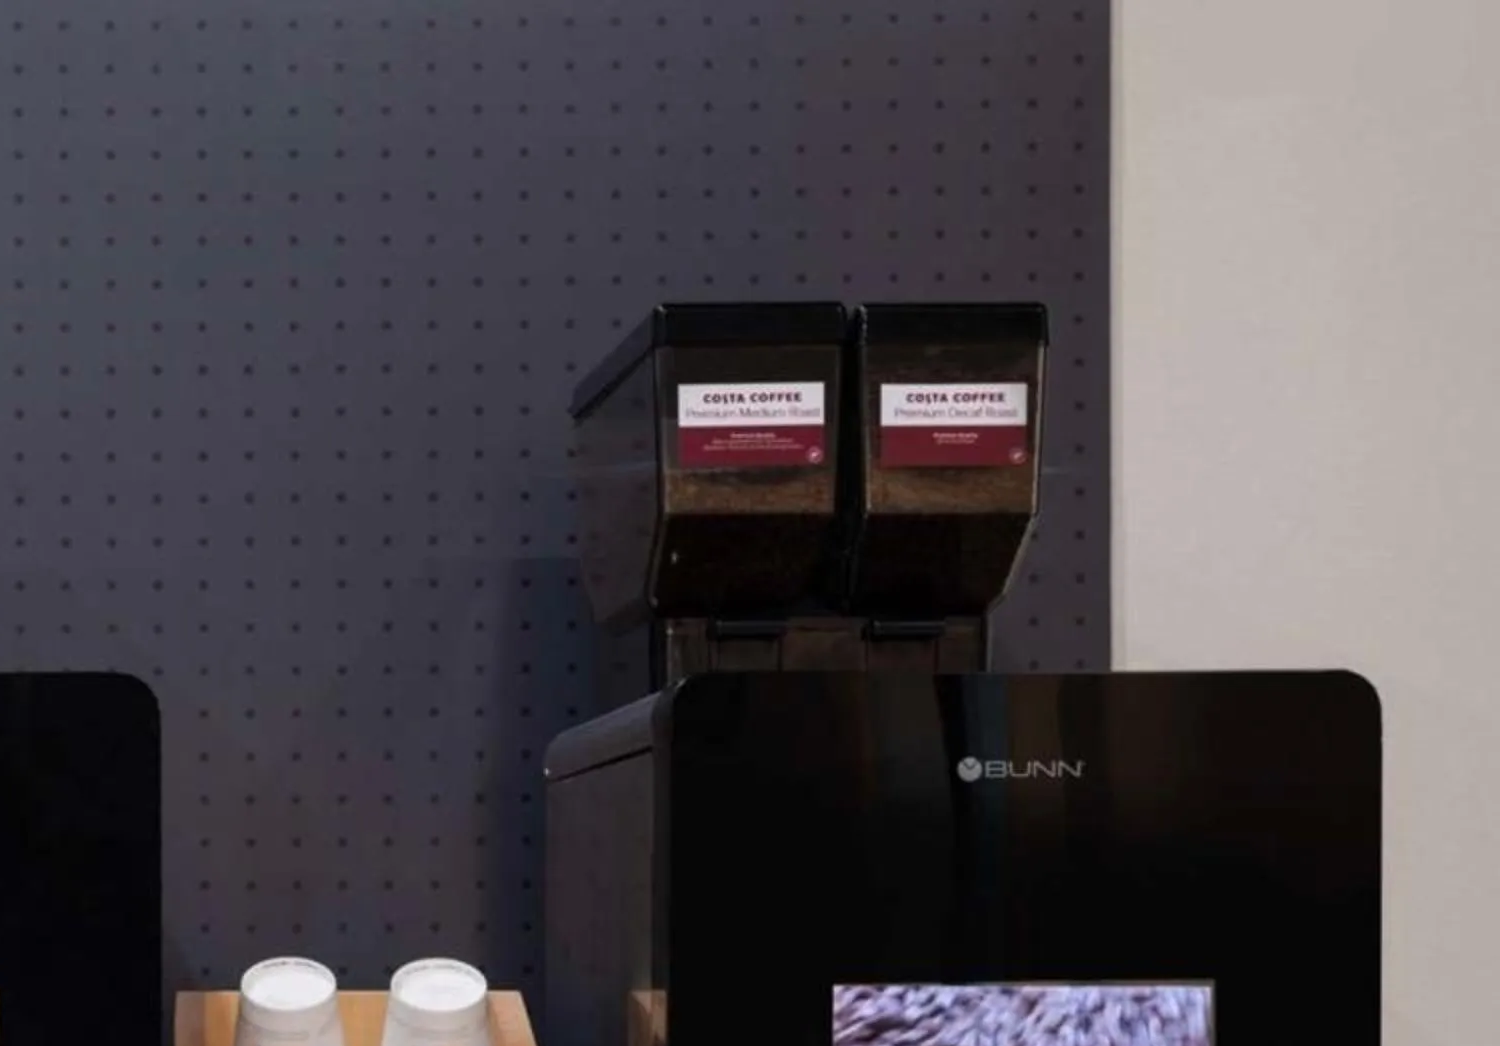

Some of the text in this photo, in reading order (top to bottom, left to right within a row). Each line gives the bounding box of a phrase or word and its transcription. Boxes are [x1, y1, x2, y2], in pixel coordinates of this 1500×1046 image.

[702, 391, 803, 405] COSTA COFFEE
[906, 391, 1005, 405] COSTA COFFEE
[984, 760, 1085, 779] BUNN
